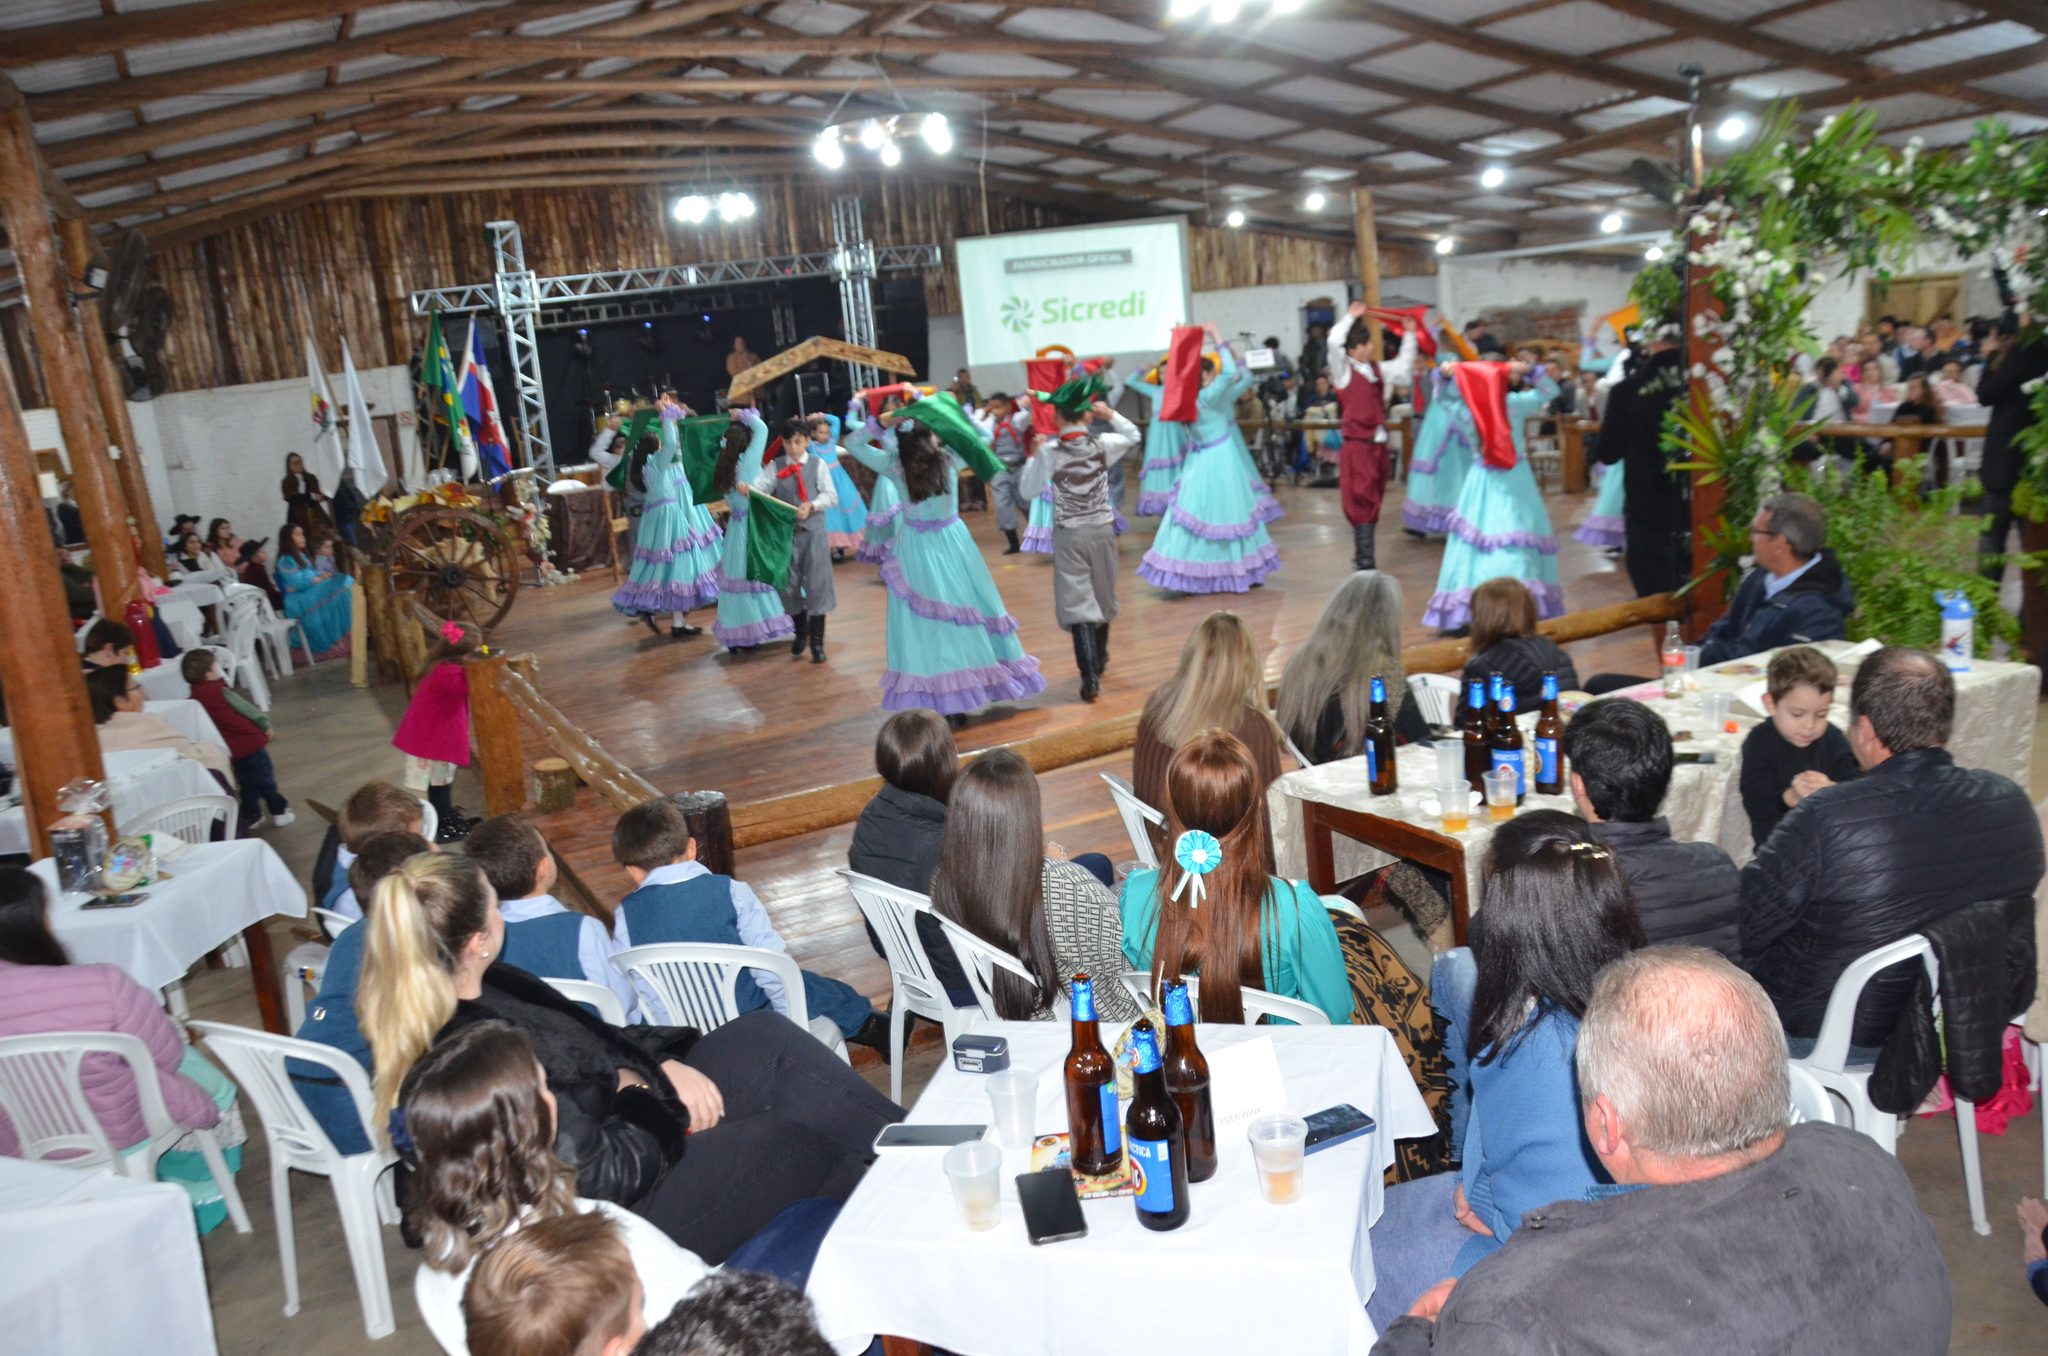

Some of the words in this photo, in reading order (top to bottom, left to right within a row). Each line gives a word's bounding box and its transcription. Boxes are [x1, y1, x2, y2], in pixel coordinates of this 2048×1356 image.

[1012, 255, 1085, 271] PATROCINADOR
[1086, 252, 1125, 264] OFICIAL
[1041, 291, 1146, 325] Sicredi
